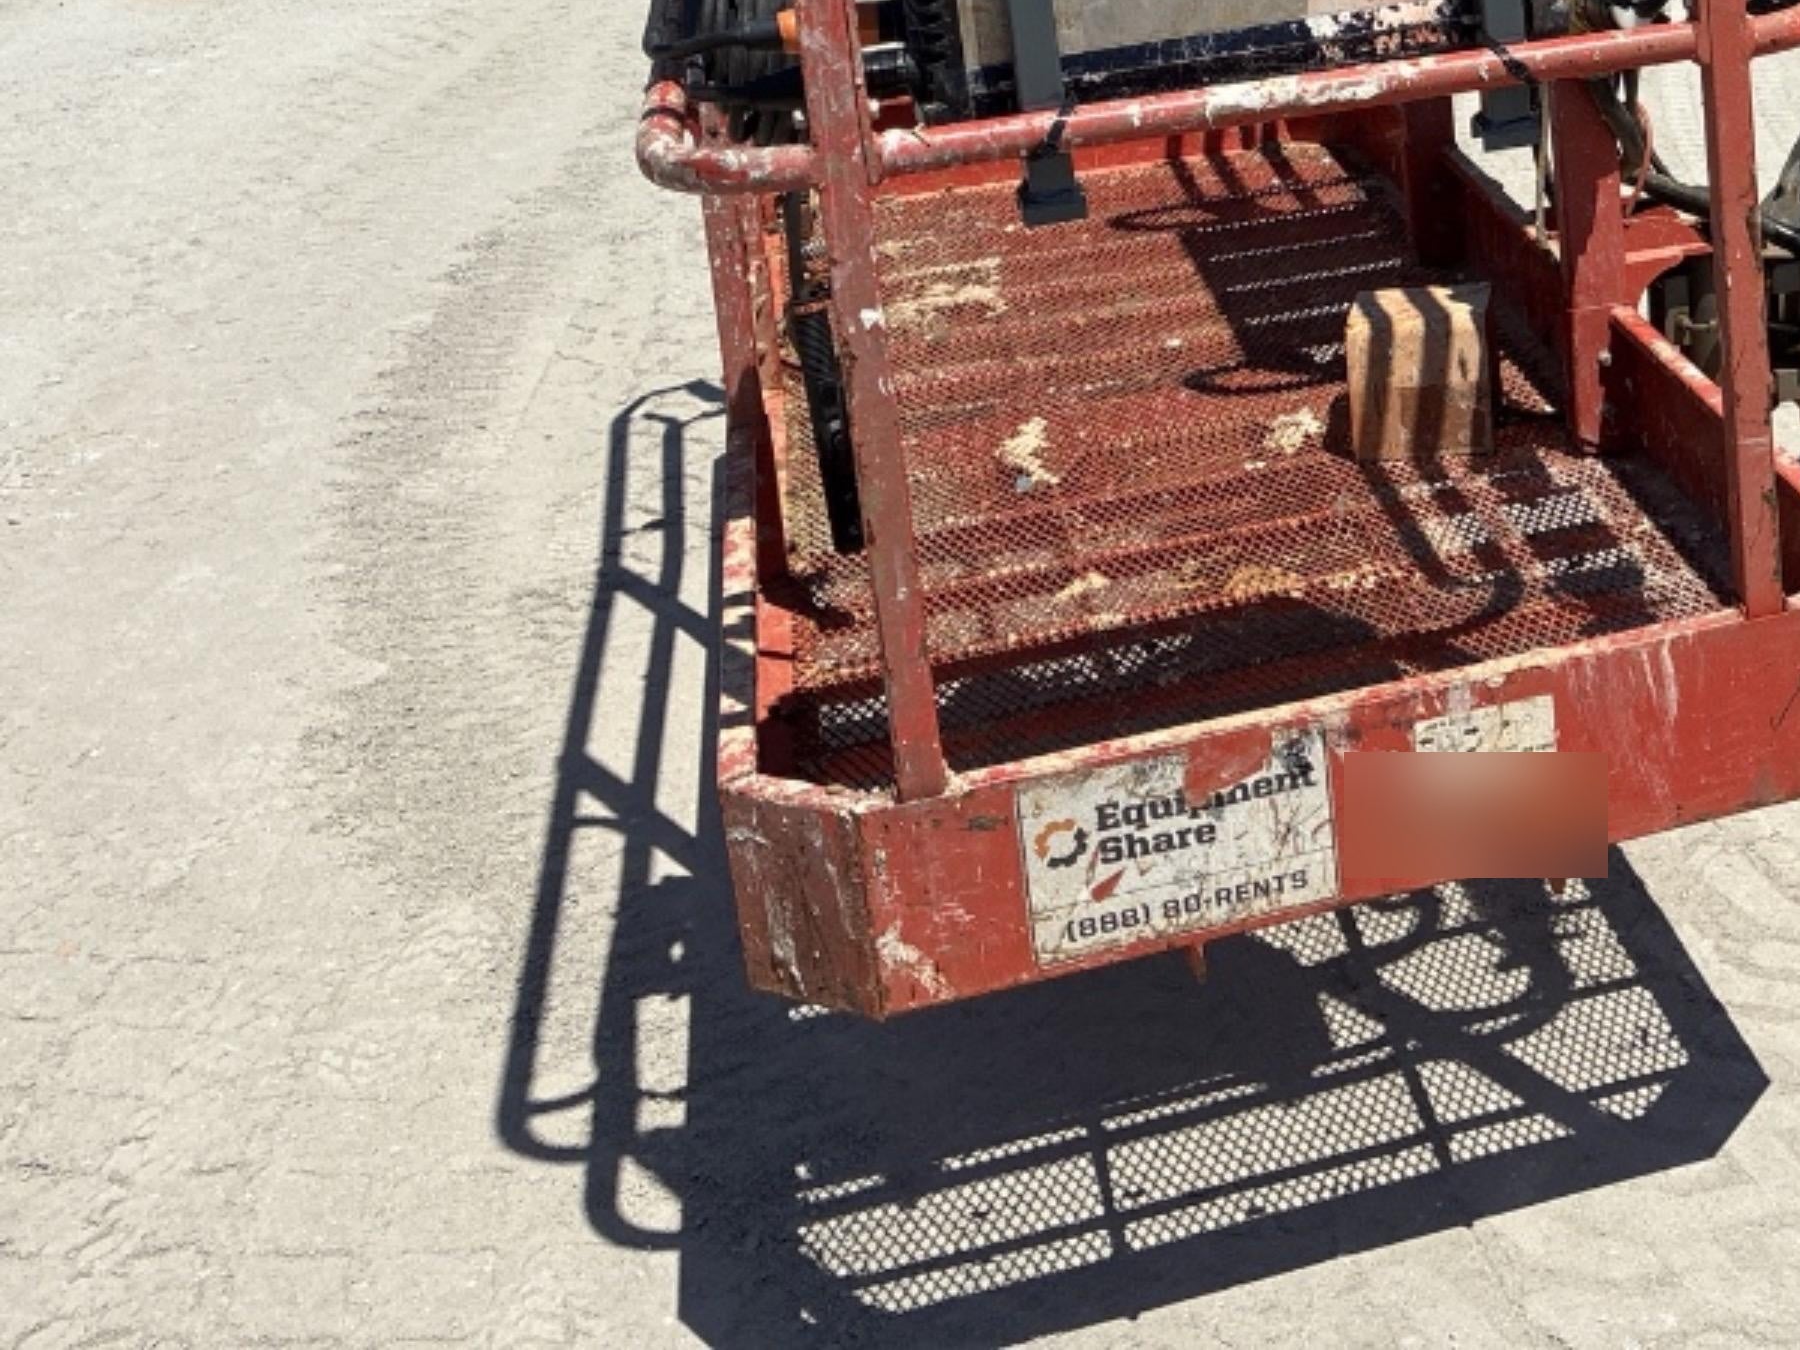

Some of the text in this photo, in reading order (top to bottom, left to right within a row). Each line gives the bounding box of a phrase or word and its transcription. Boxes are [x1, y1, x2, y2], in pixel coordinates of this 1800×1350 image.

[1100, 822, 1216, 864] Share
[1066, 869, 1309, 943] (888) 80-RENTS
